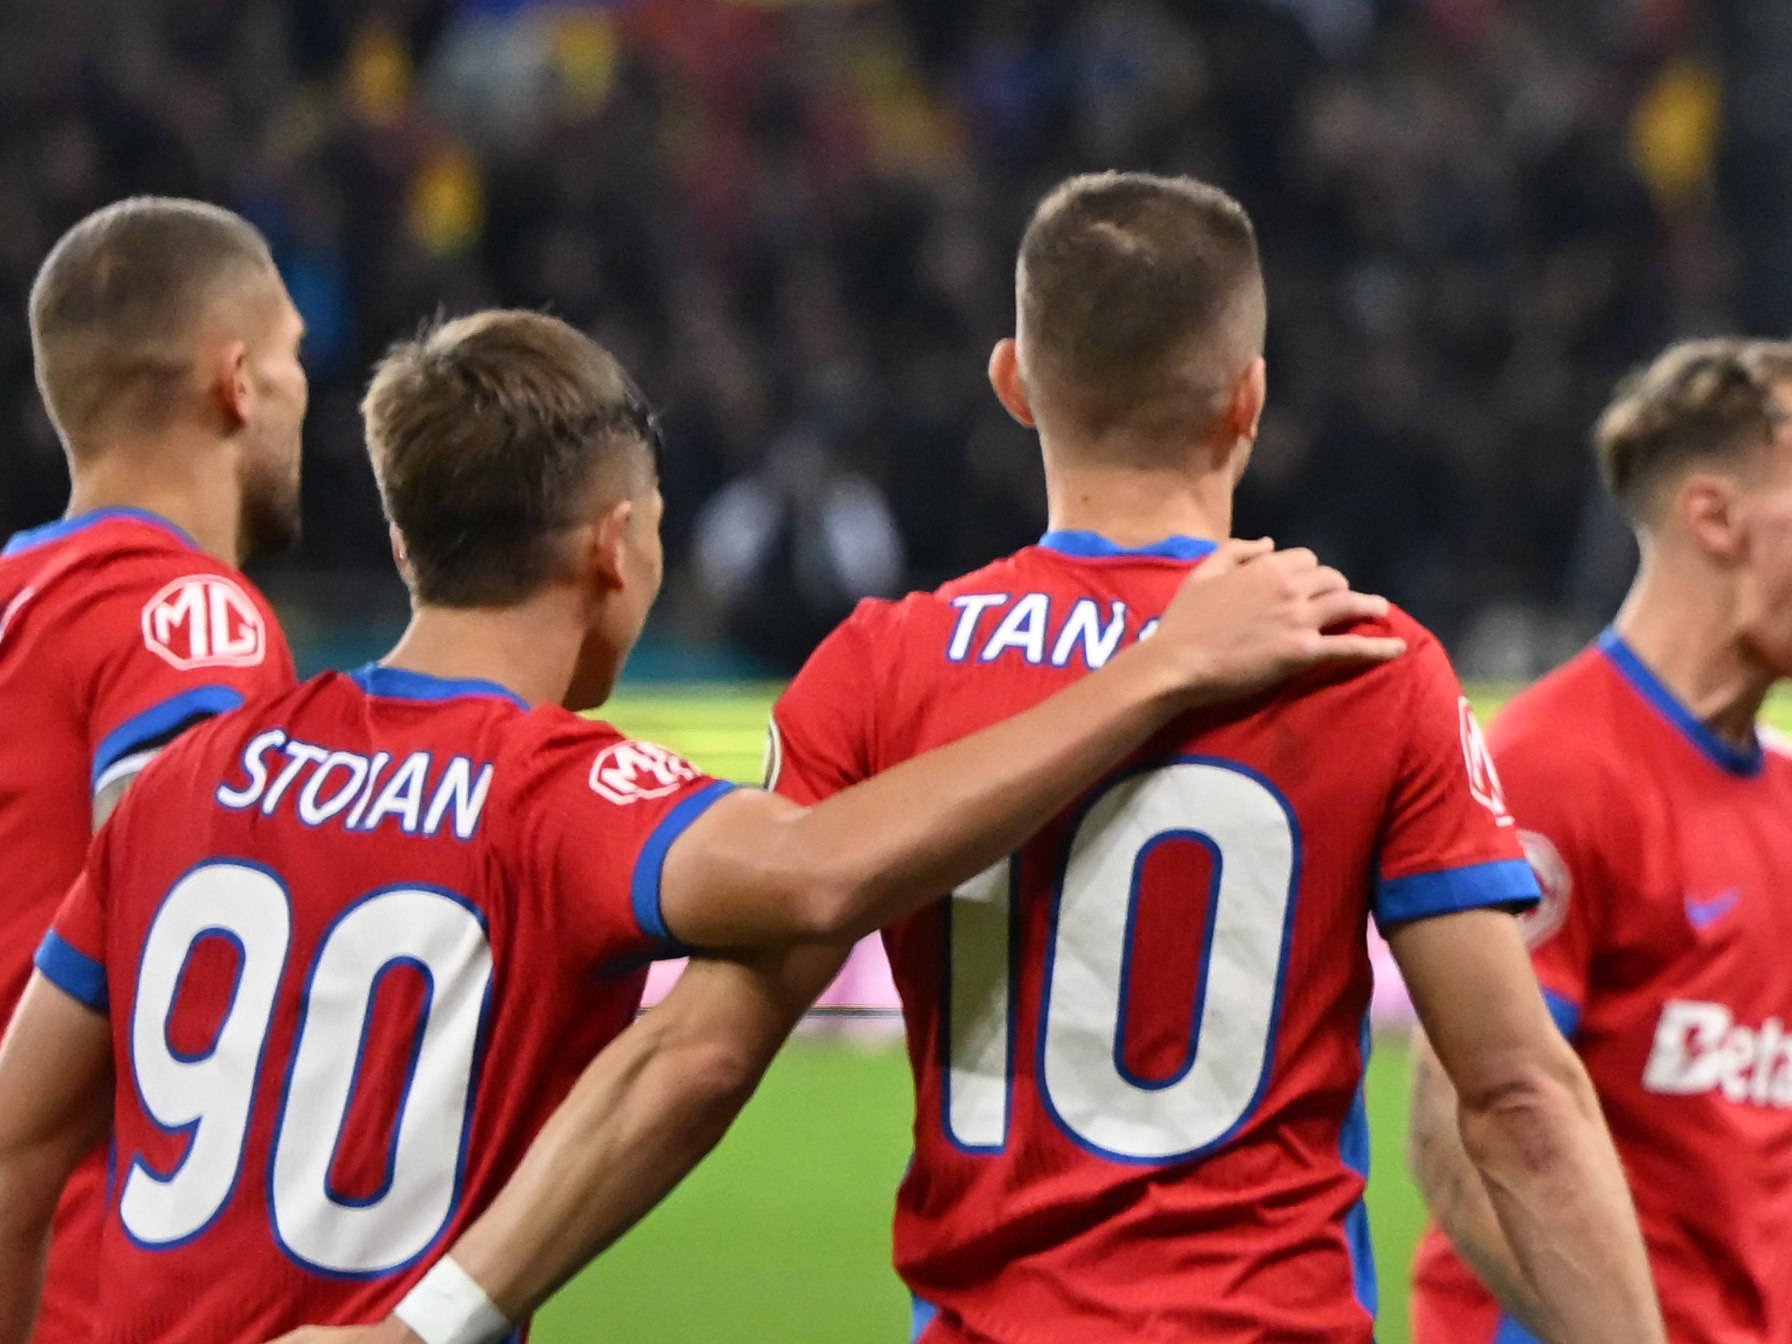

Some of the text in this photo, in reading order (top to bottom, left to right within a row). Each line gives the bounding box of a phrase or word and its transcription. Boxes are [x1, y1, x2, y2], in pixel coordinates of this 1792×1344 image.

[151, 578, 260, 661] MG
[948, 592, 1160, 672] TAN
[215, 728, 493, 839] STOIAN
[939, 754, 1301, 1165] 10
[119, 857, 494, 1279] 90
